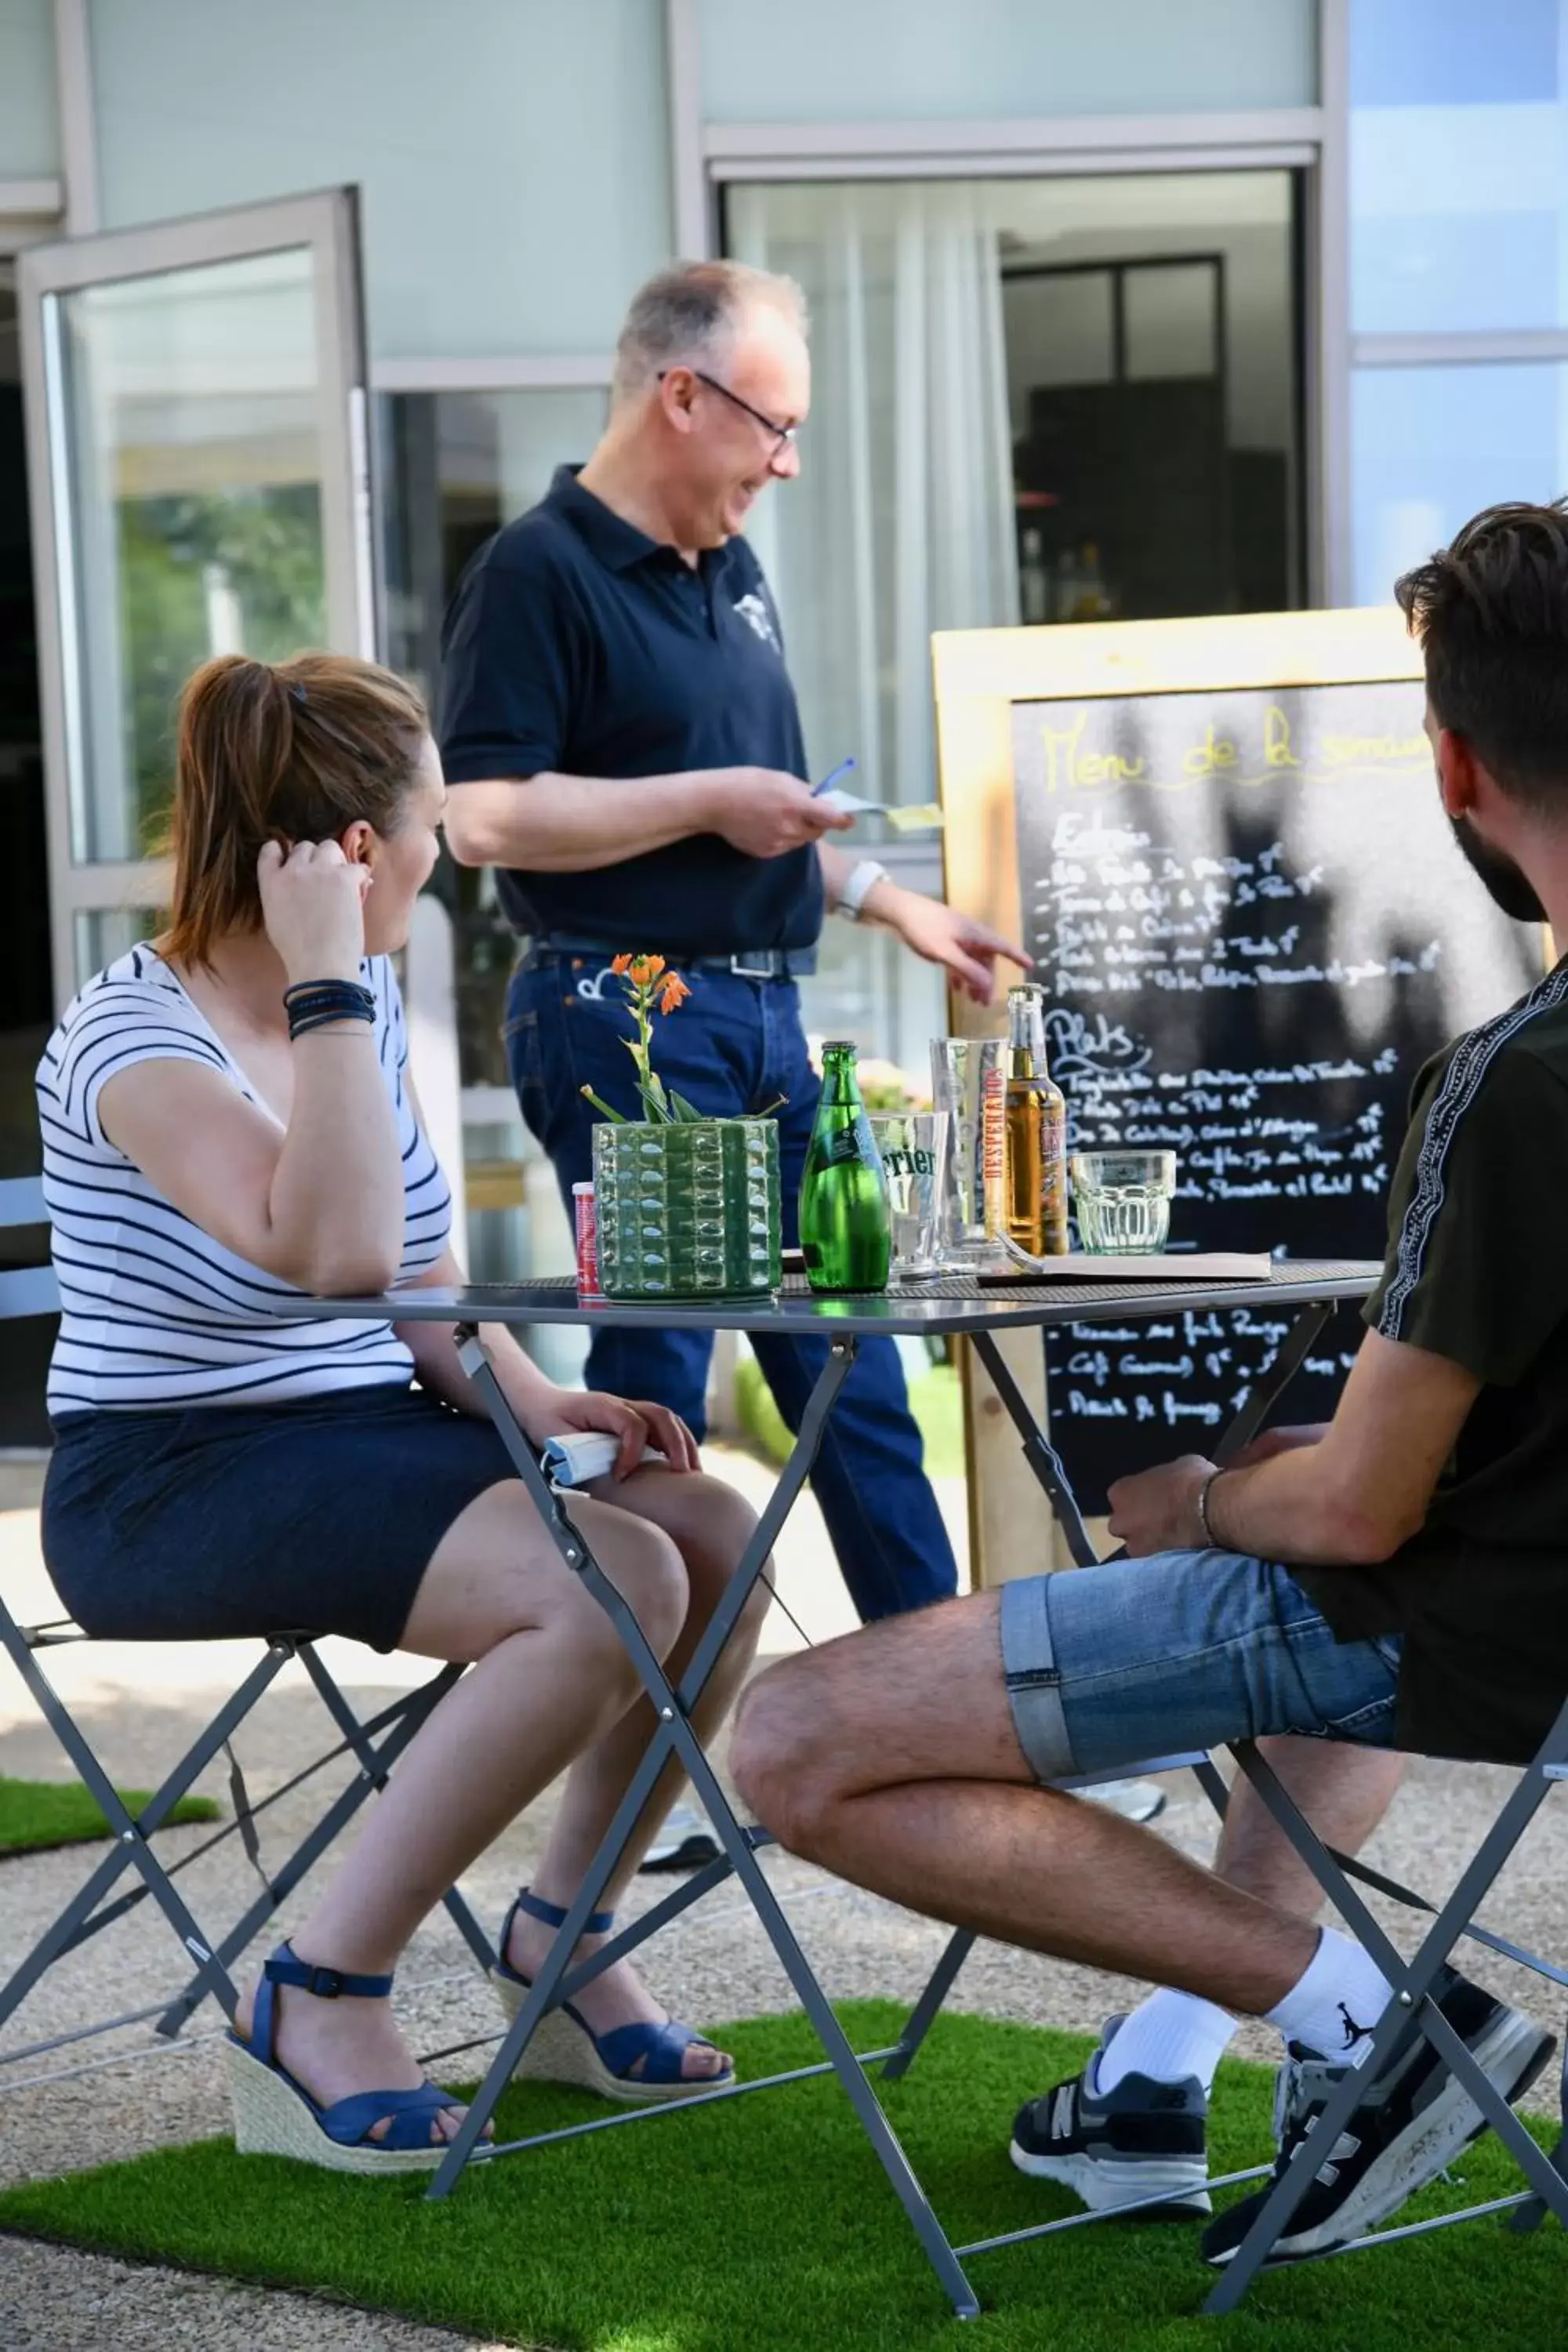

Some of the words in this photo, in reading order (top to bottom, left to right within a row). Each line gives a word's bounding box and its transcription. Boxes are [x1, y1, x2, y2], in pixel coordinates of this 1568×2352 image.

[1040, 709, 1144, 792] Menu
[1182, 724, 1239, 776] de
[1264, 706, 1300, 767] la
[882, 1145, 936, 1177] rrier
[985, 1068, 1004, 1178] DESPERADOS
